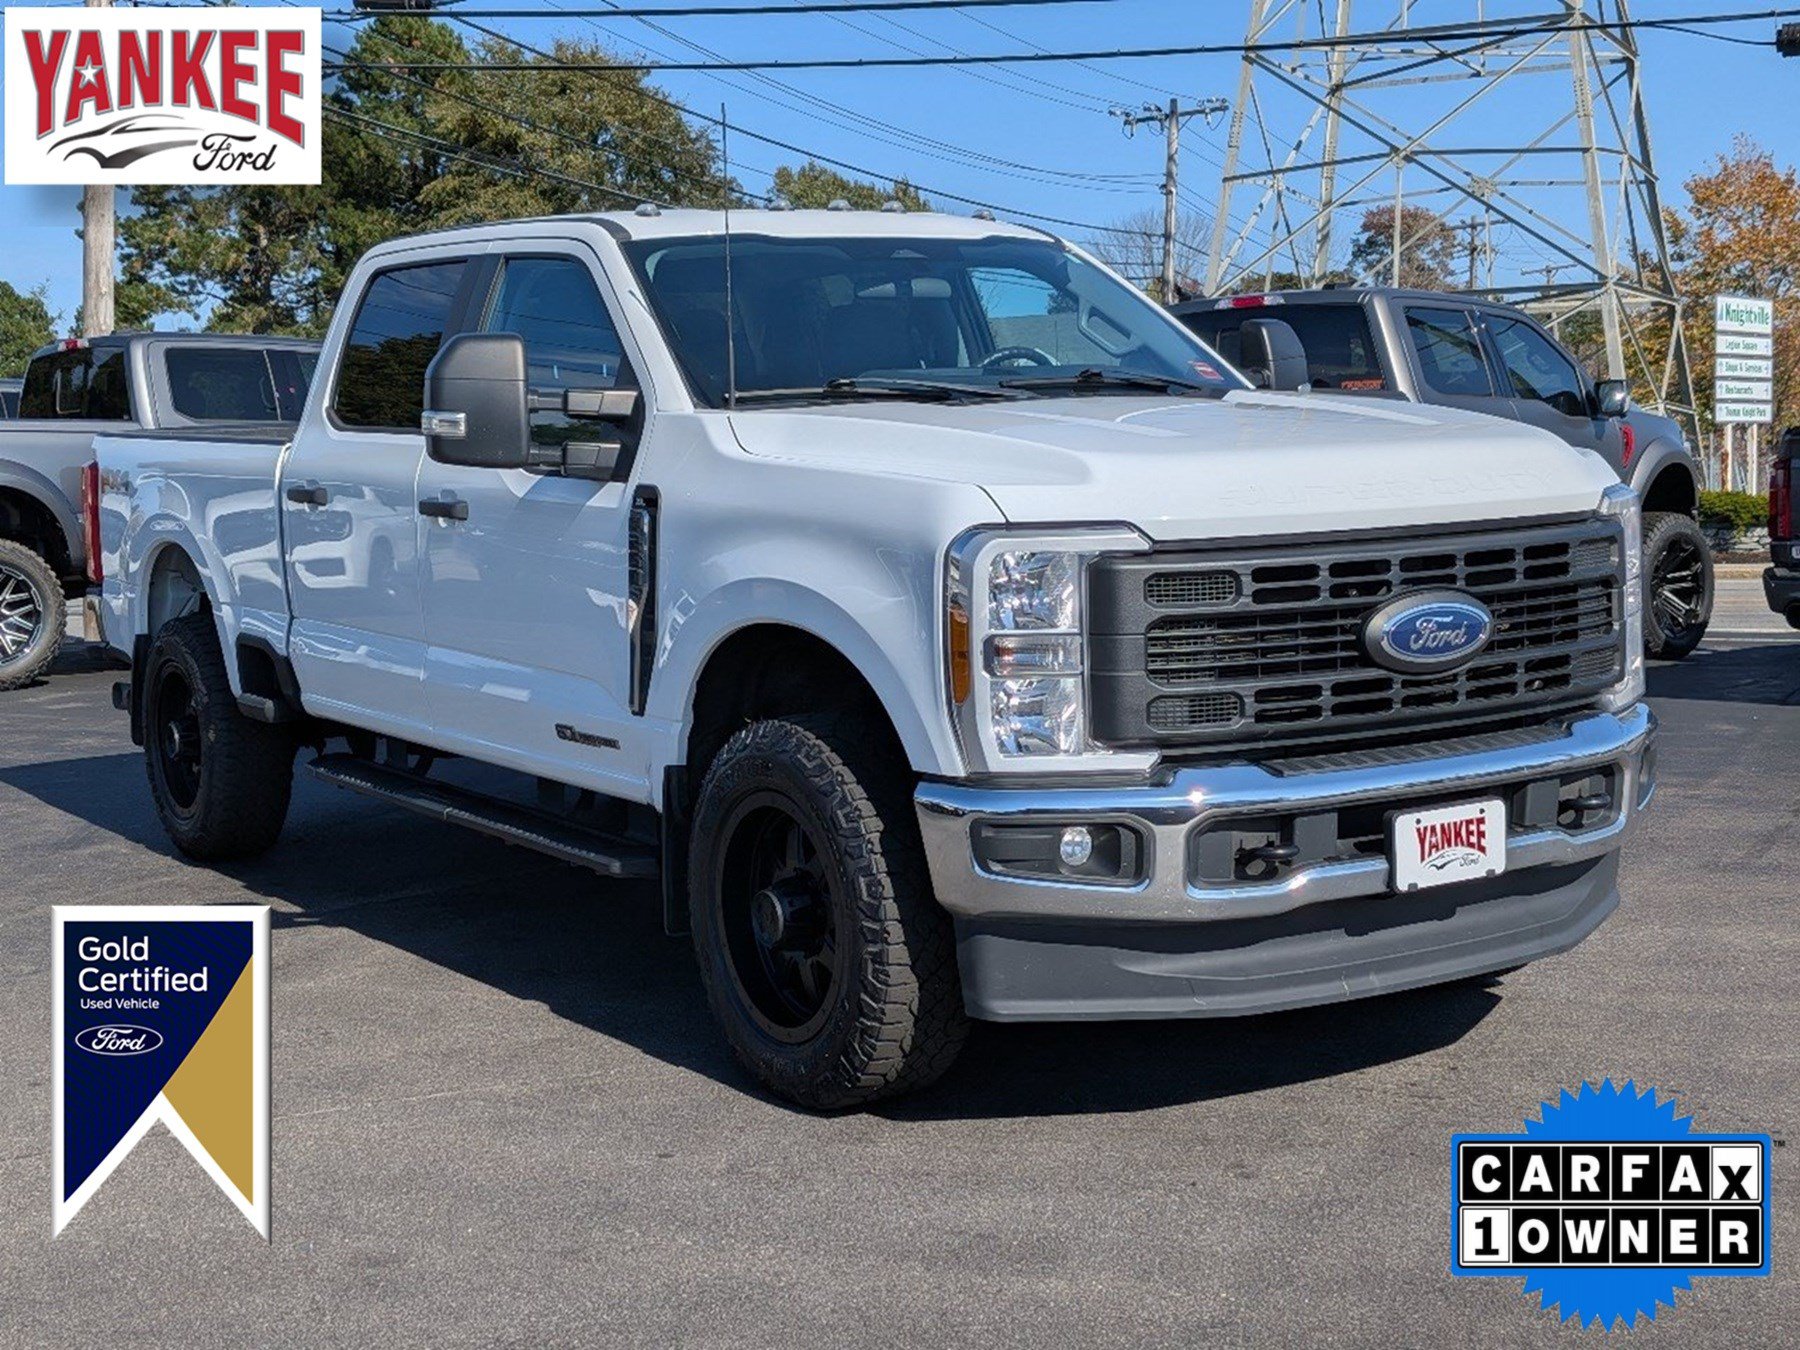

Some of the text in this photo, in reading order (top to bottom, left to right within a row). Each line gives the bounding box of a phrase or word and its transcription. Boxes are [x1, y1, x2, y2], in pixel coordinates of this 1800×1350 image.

[1724, 302, 1770, 326] Knightville
[1725, 384, 1754, 395] Restaurants
[1409, 615, 1469, 650] Ford
[1415, 816, 1487, 863] YANKEE
